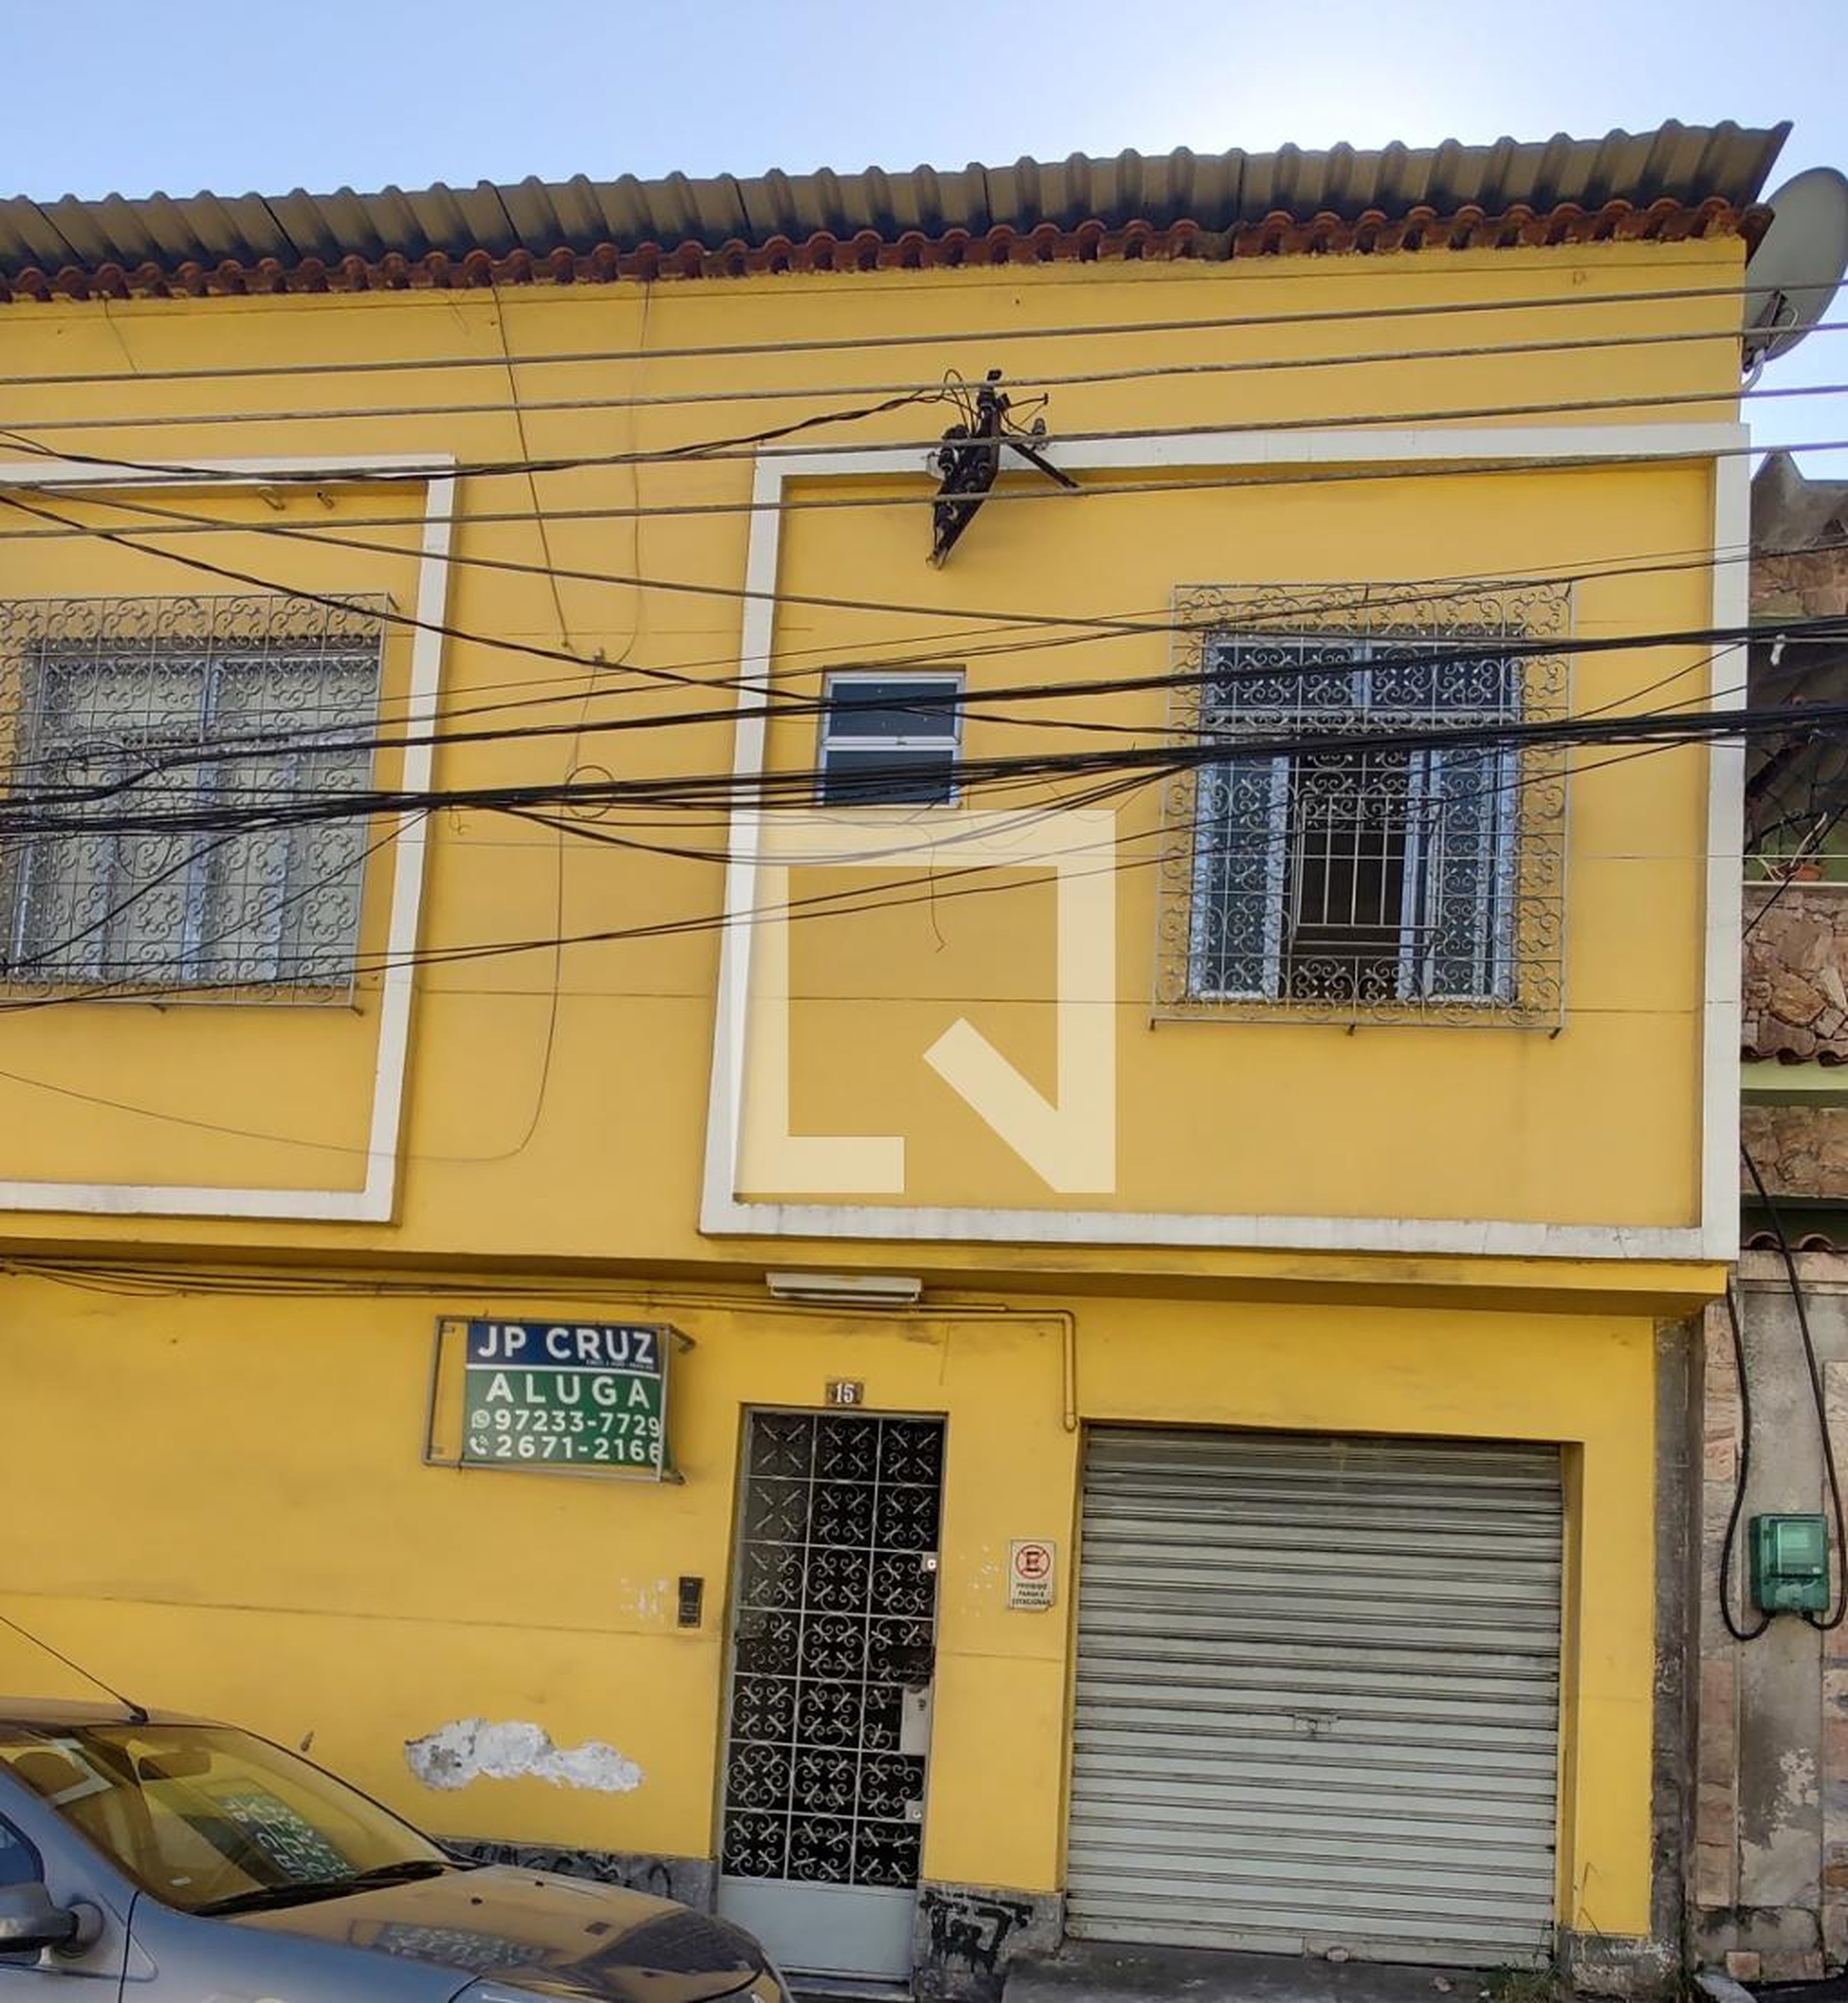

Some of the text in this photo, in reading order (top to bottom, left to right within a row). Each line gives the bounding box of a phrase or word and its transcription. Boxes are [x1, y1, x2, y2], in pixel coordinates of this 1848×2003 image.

[478, 1326, 654, 1363] JP CRUZ
[486, 1373, 650, 1409] ALUGA
[836, 1383, 854, 1403] 15
[495, 1408, 660, 1438] 97233-7729
